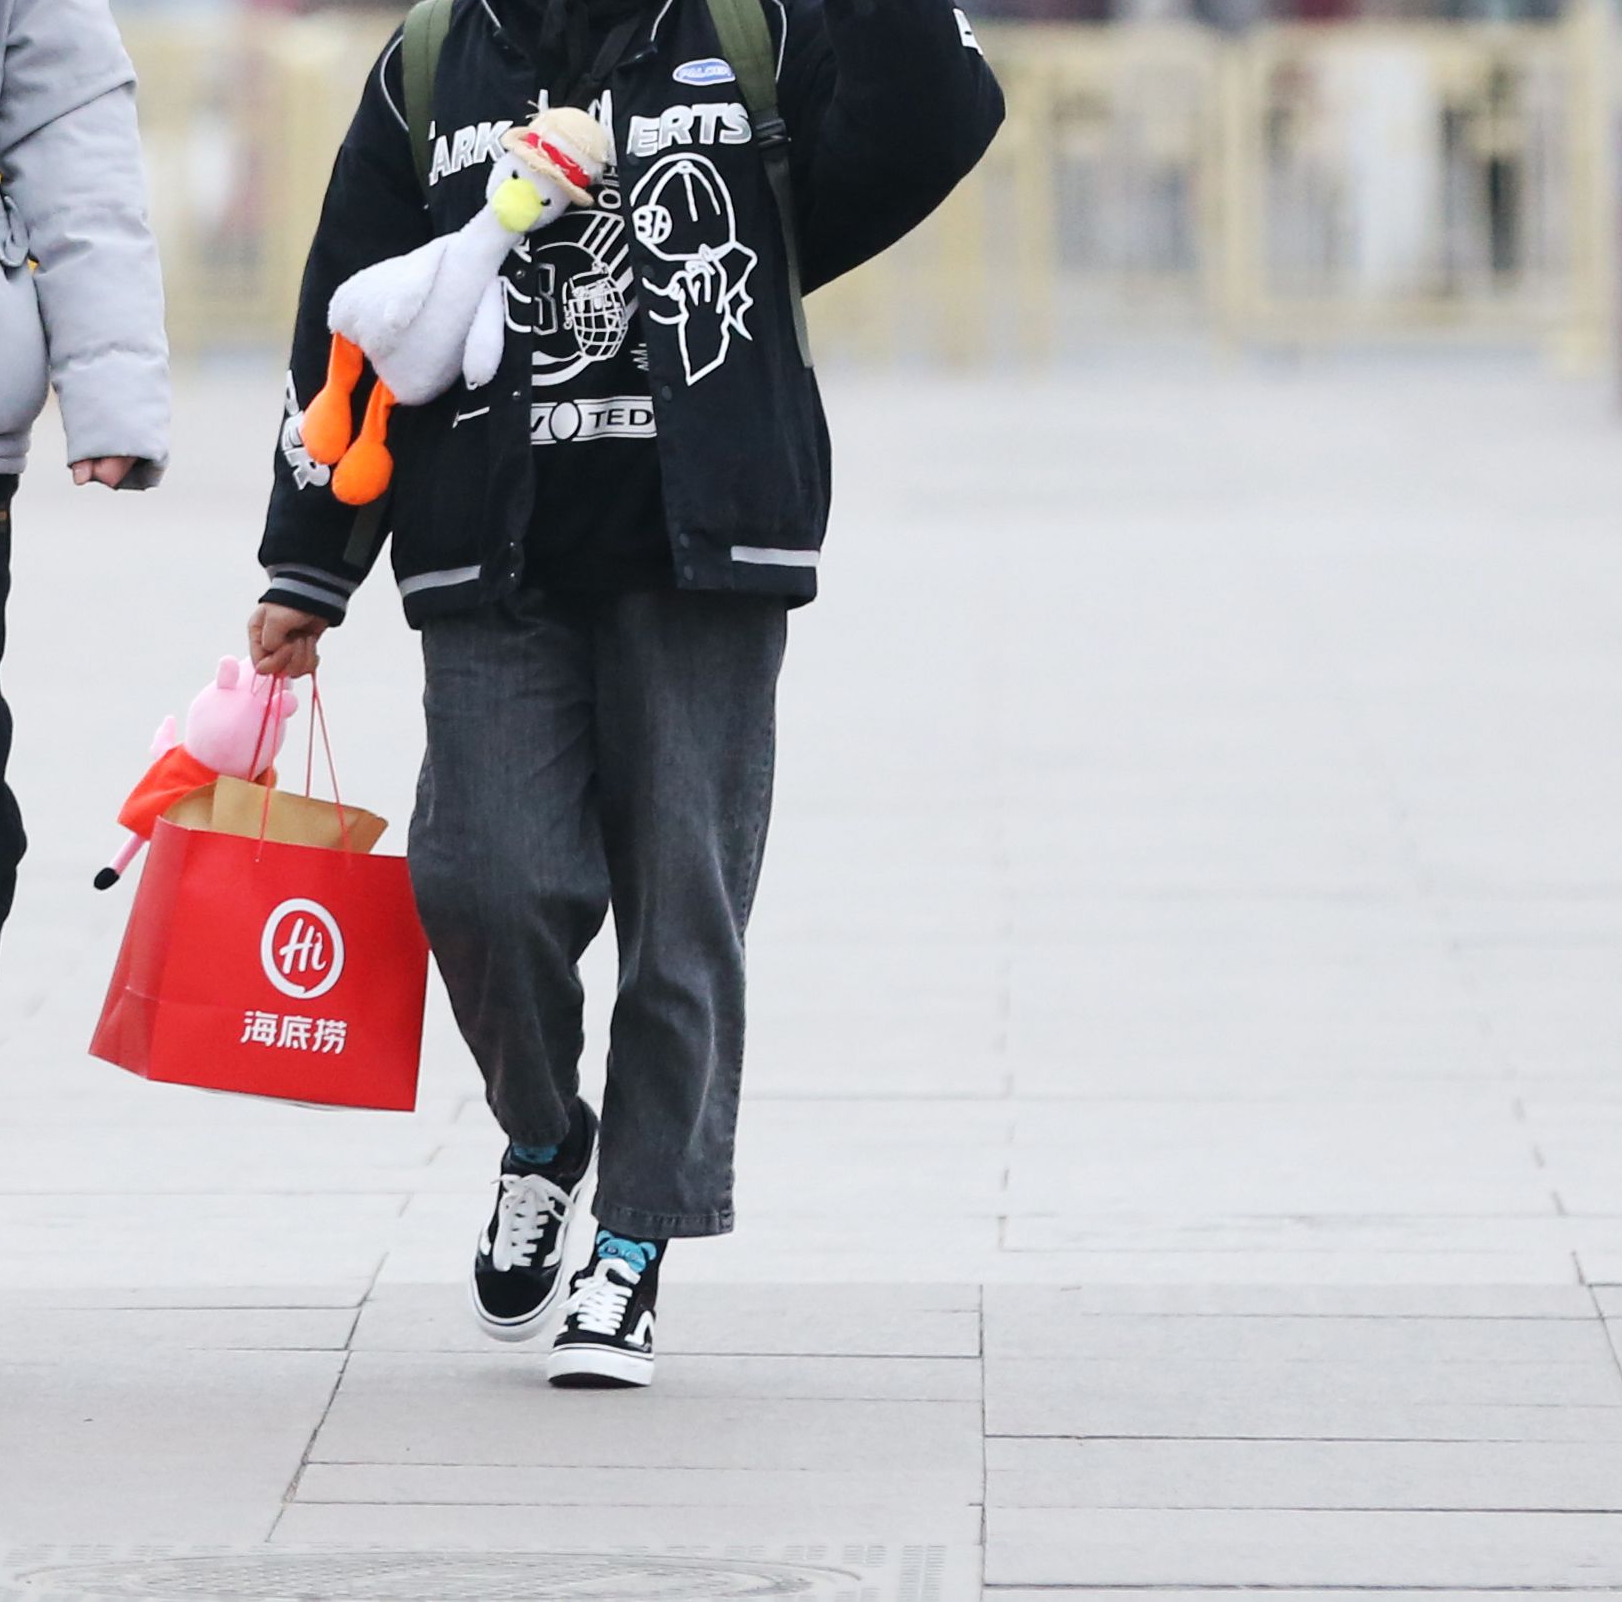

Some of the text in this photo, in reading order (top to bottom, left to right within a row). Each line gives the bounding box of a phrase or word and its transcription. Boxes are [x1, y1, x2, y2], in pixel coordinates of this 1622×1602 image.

[428, 120, 513, 187] ARK
[279, 917, 327, 974] Hi
[240, 1010, 347, 1054] 海底捞
